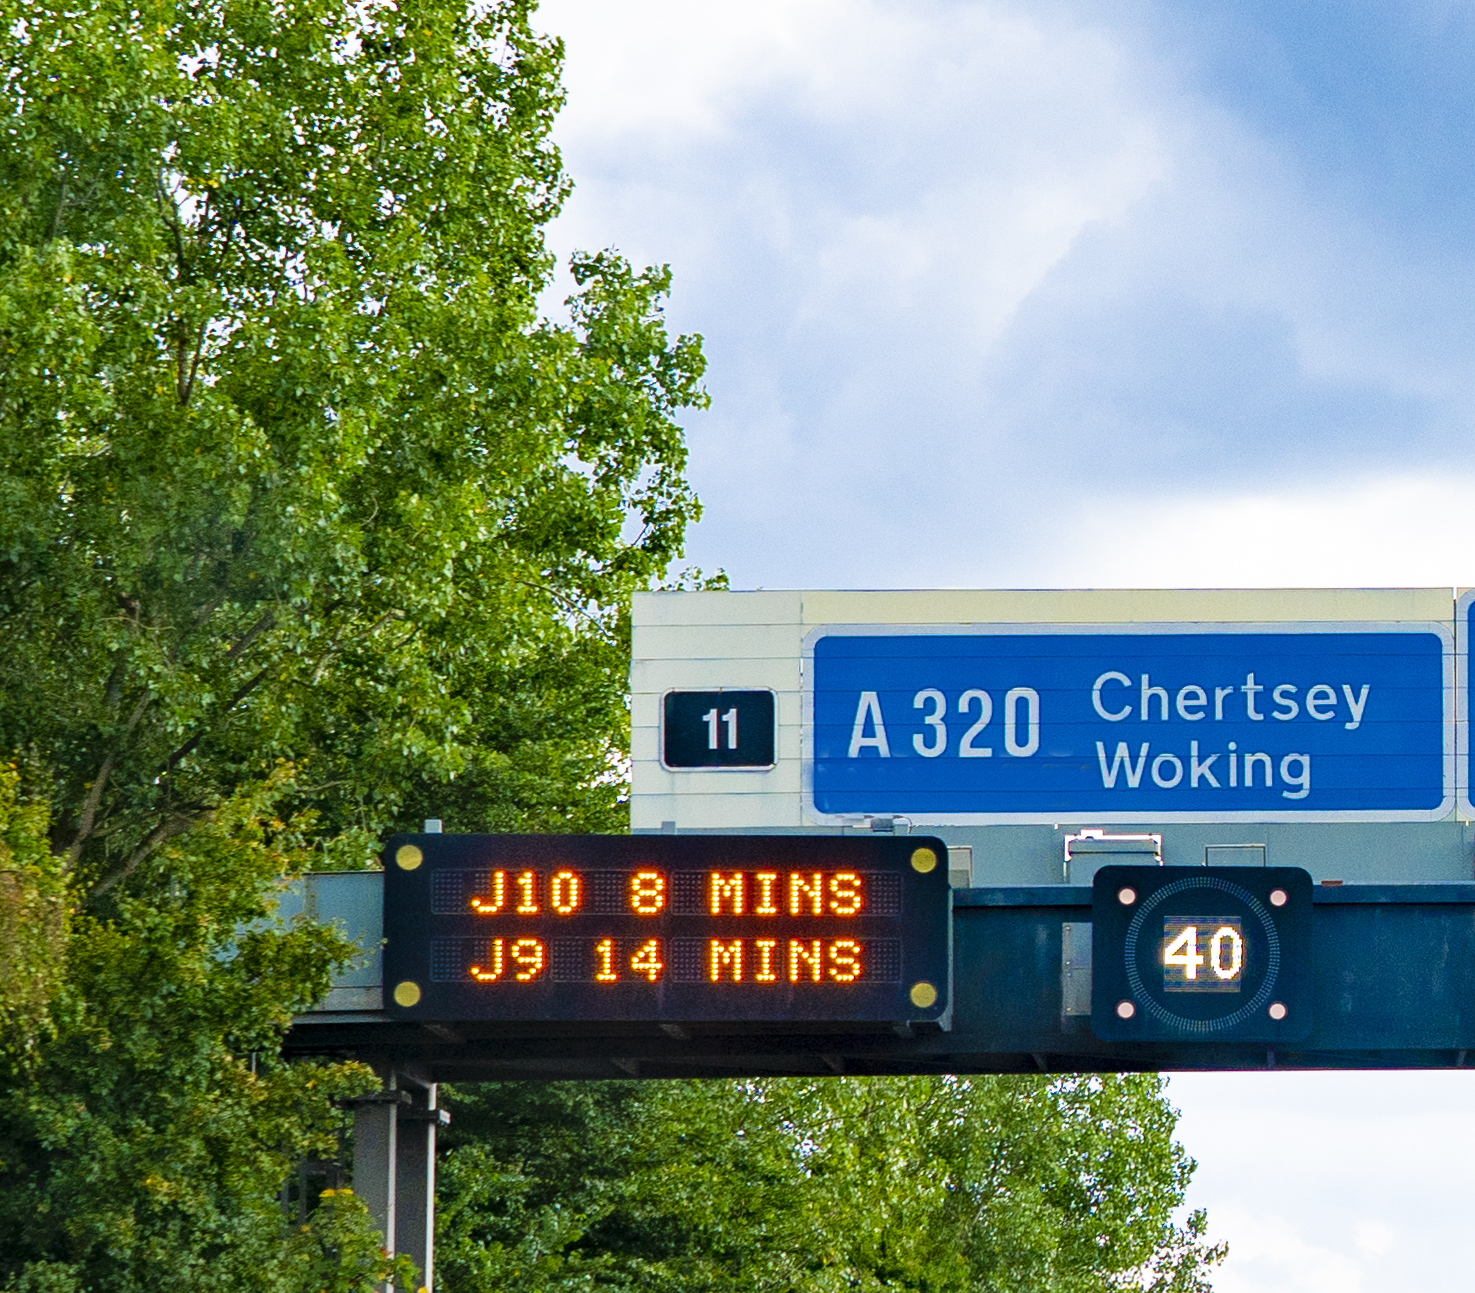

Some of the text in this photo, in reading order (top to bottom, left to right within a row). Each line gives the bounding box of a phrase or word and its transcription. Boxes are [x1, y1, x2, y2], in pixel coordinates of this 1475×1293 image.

[1092, 671, 1370, 730] Chertsey
[703, 708, 738, 750] 11
[1096, 740, 1311, 799] Woking
[470, 868, 863, 917] J10 8 MINS
[469, 936, 863, 984] J9 14 MINS
[1164, 925, 1242, 979] 40
